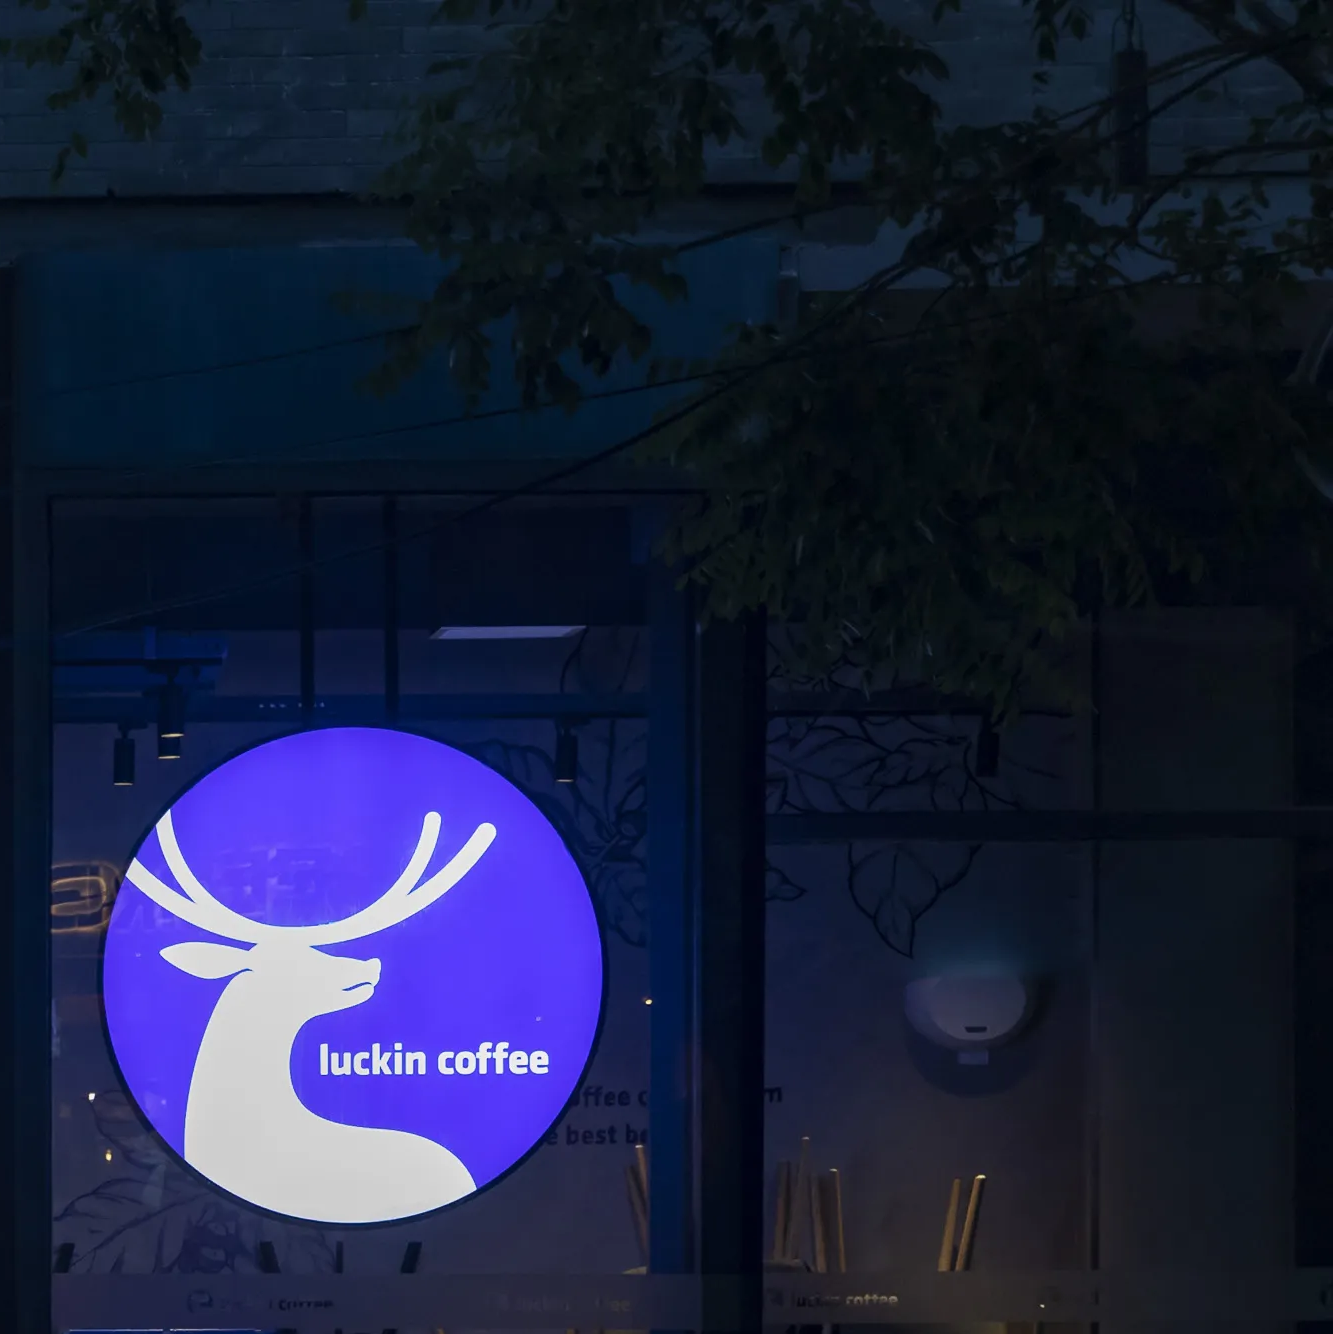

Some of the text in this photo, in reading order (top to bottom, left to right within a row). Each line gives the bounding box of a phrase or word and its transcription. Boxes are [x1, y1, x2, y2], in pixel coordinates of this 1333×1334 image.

[319, 1041, 549, 1076] luckin coffee
[566, 1125, 617, 1146] best
